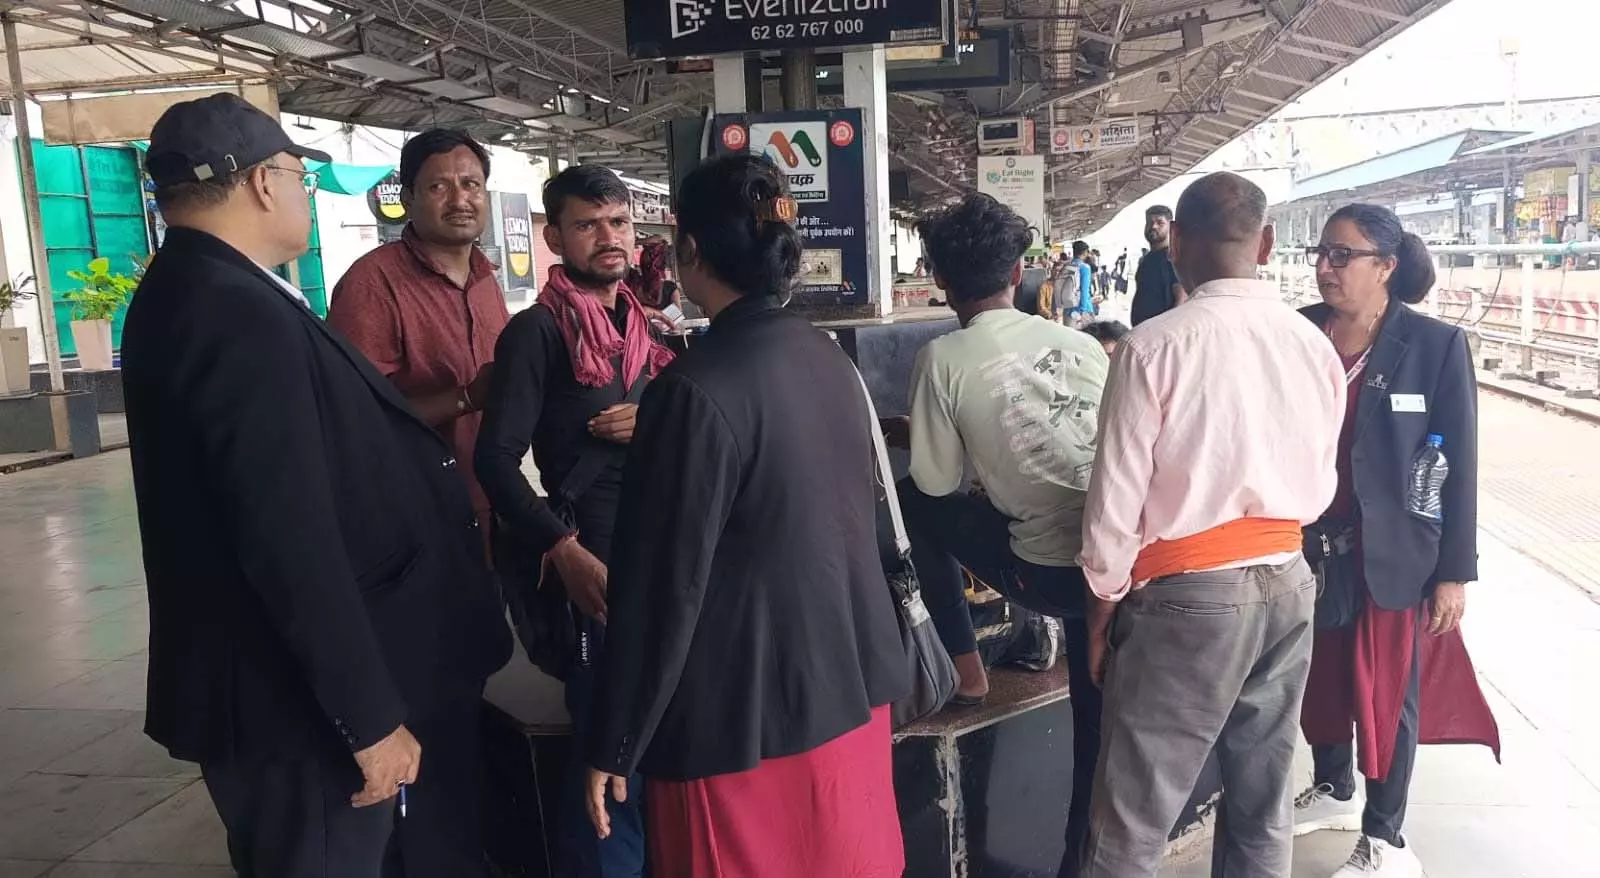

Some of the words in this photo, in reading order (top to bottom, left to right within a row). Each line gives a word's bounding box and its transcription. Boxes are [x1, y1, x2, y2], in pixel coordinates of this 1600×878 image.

[751, 26, 771, 40] 62
[775, 24, 795, 38] 62
[800, 21, 828, 36] 767
[834, 19, 864, 34] 000
